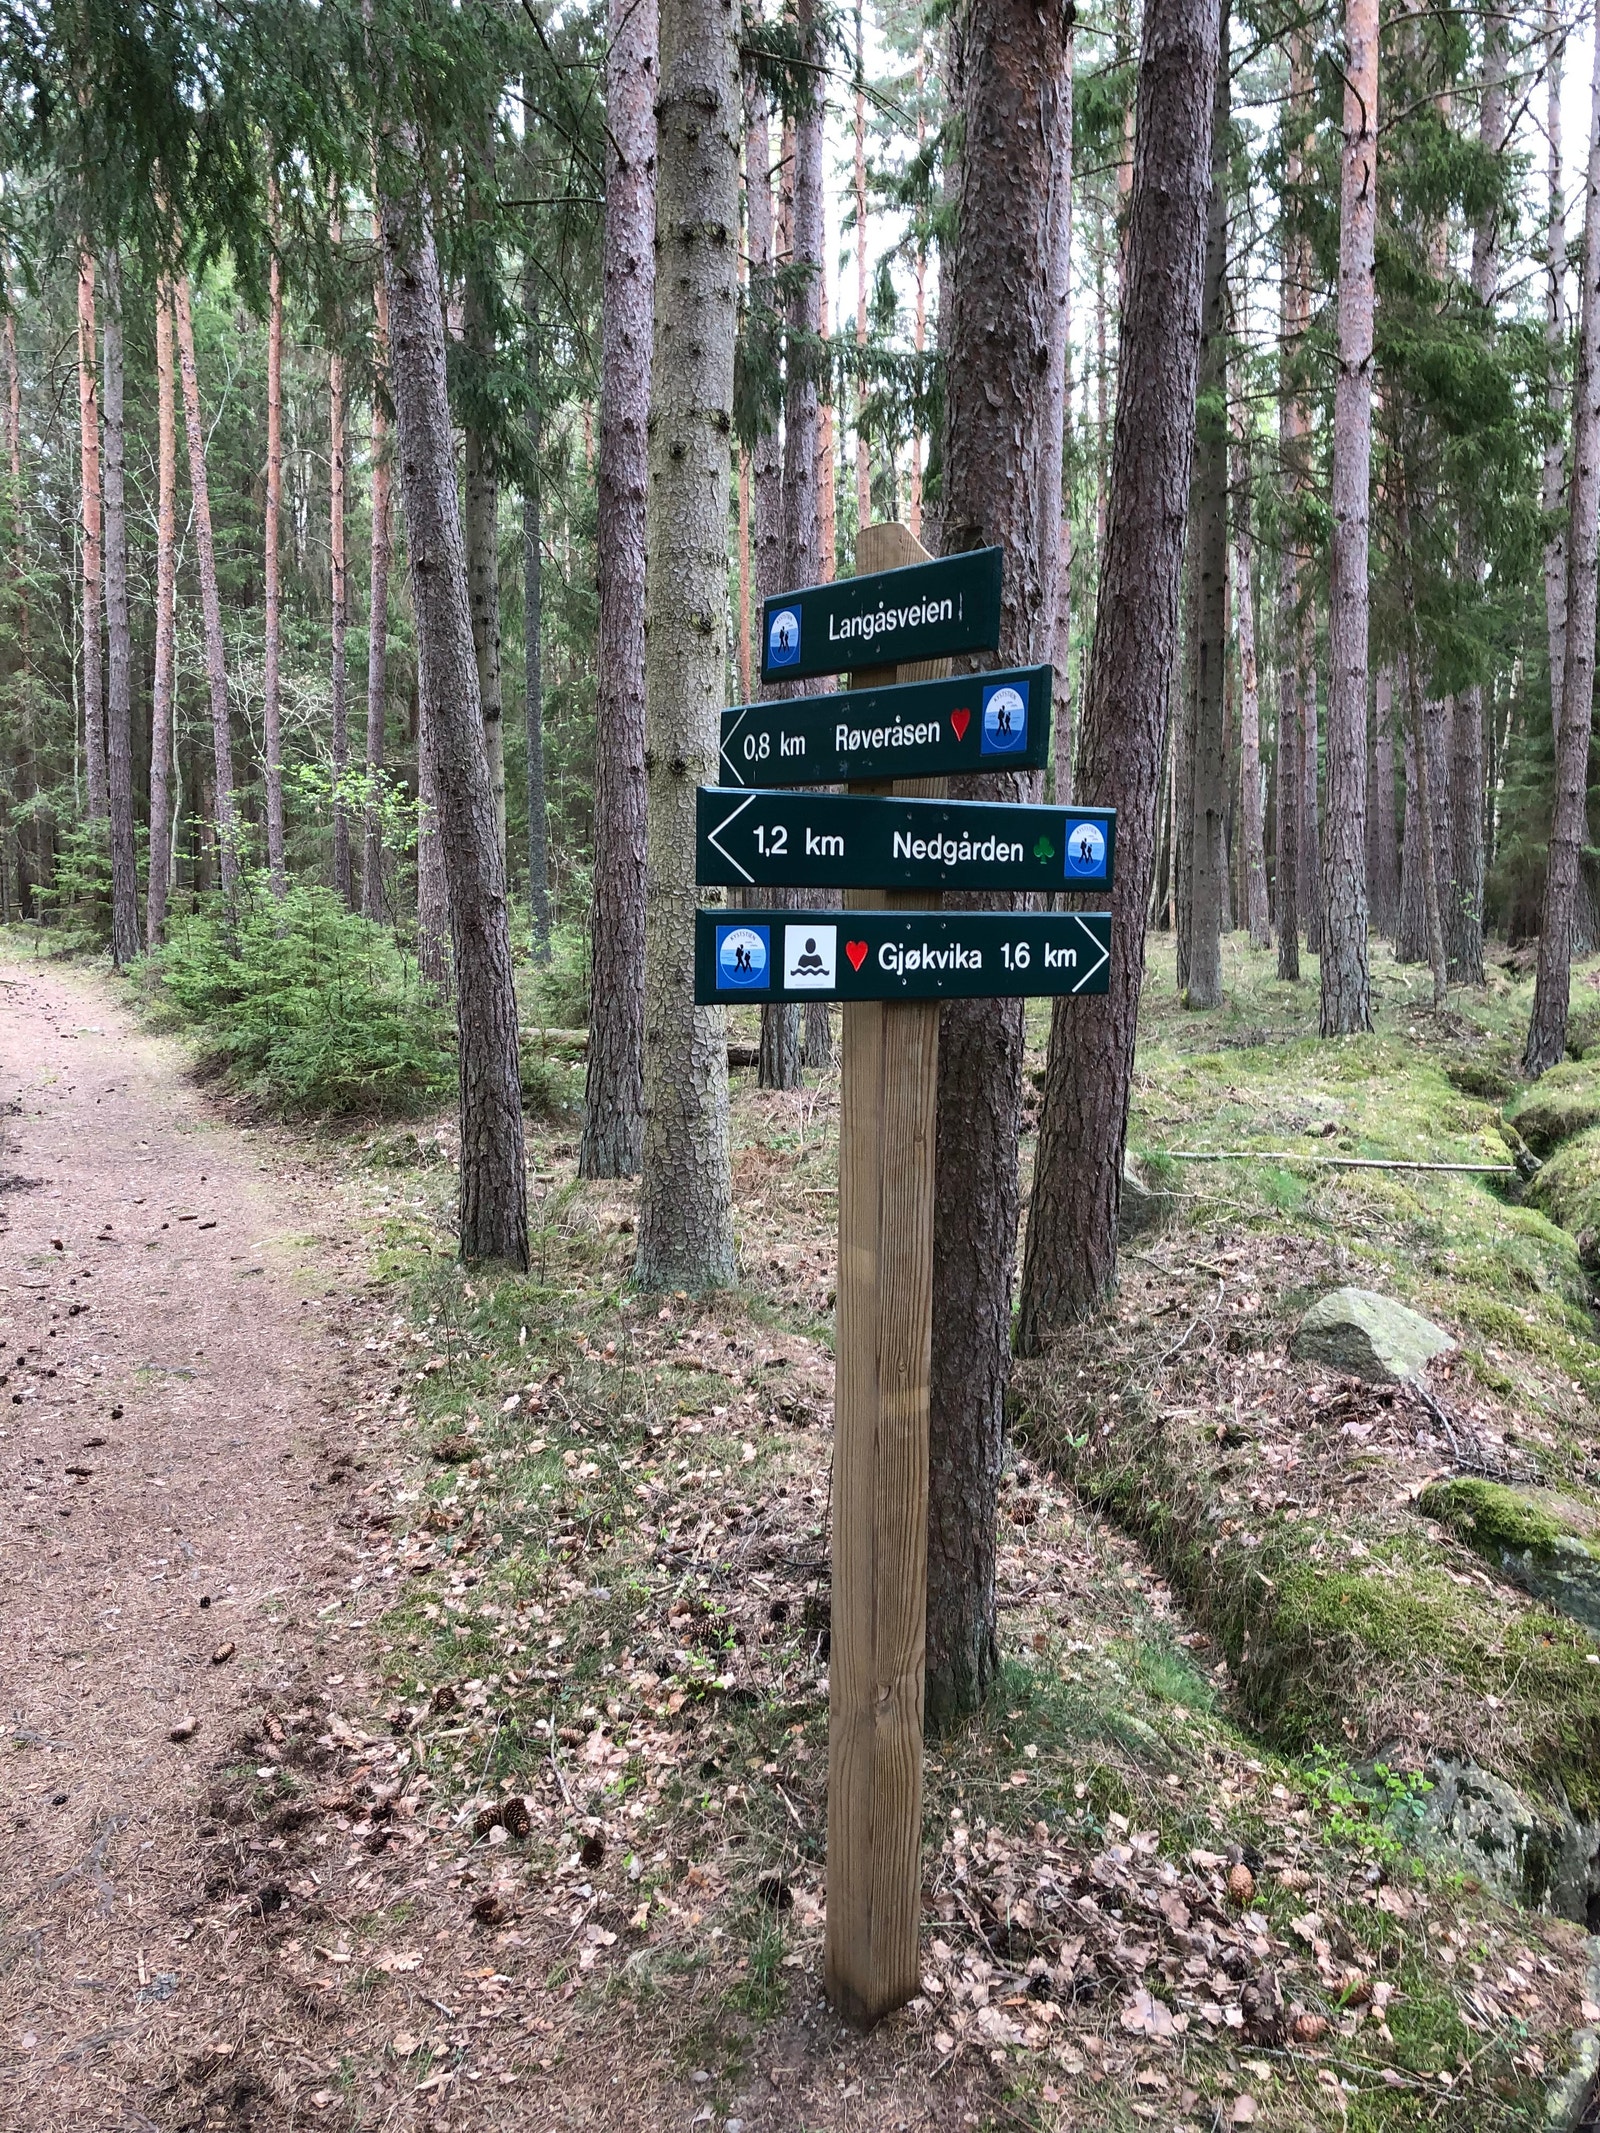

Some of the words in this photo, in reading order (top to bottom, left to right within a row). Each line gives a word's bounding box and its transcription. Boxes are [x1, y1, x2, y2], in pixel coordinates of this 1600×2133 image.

[829, 595, 953, 641] Langåsveien
[743, 732, 771, 762] 0,8
[780, 730, 806, 757] km
[835, 715, 941, 752] Røveråsen
[753, 825, 788, 858] 1,2
[805, 828, 845, 857] km
[892, 831, 1024, 866] Nedgården
[878, 942, 983, 976] Gjøkvika
[1000, 941, 1031, 971] 1,6
[1044, 942, 1077, 968] km
